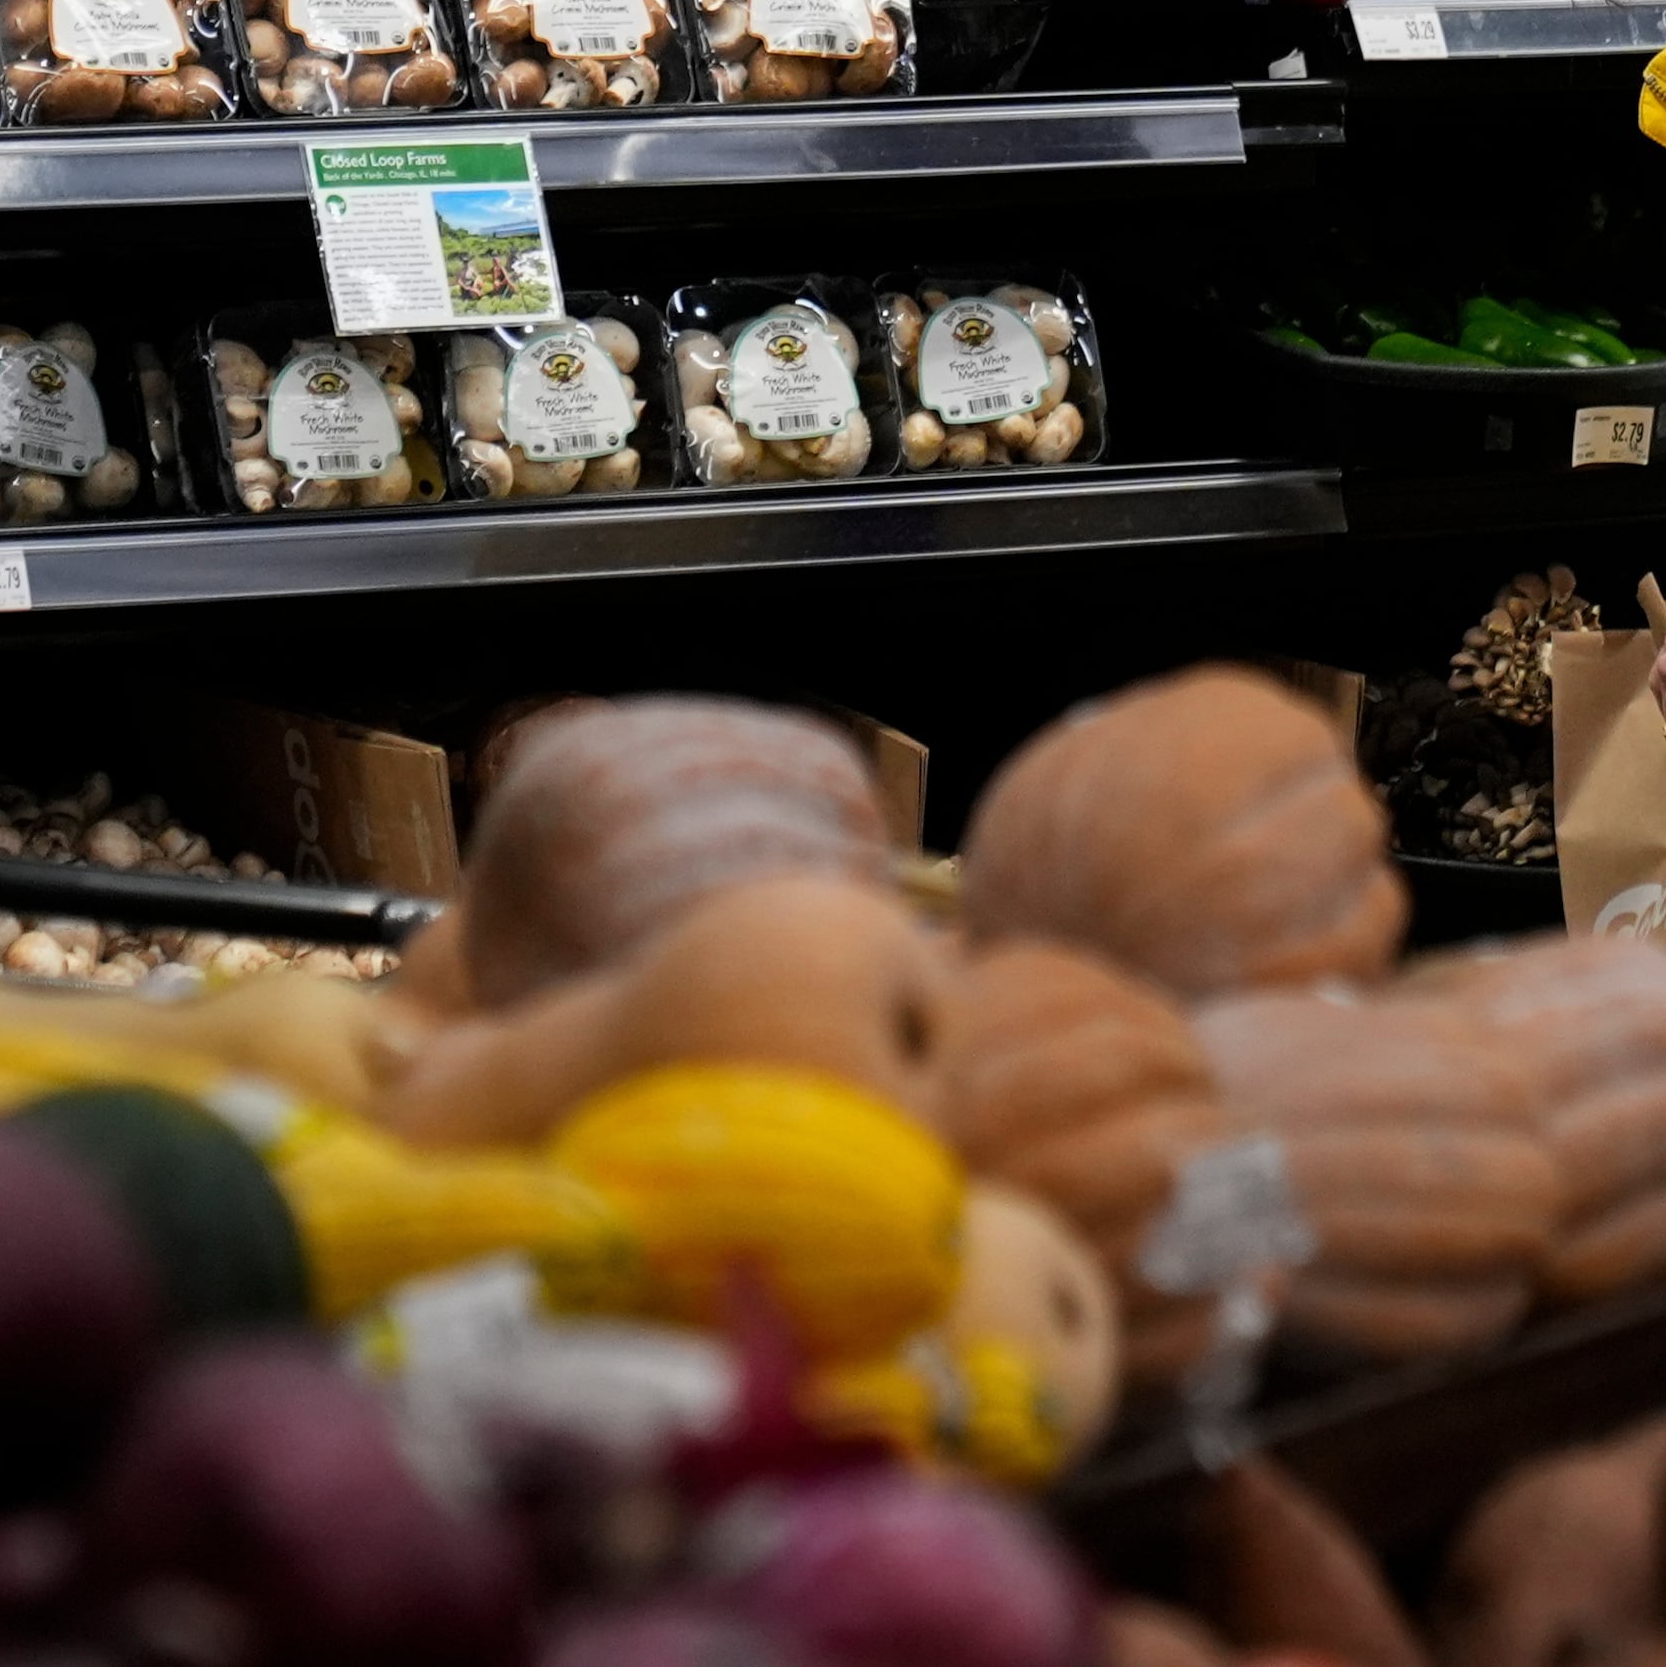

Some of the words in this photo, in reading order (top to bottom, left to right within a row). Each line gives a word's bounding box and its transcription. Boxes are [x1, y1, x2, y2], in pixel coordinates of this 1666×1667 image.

[320, 150, 367, 170] Closed
[369, 152, 405, 170] Loop
[406, 151, 447, 167] Farms
[948, 357, 978, 373] Fresh
[980, 352, 1012, 368] White
[762, 374, 789, 387] Fresh
[791, 371, 822, 384] White
[956, 366, 1008, 382] Mushrooms
[769, 383, 817, 396] Mushrooms
[535, 396, 565, 409] Fresh
[570, 392, 599, 405] White
[13, 398, 41, 415] Fresh
[44, 404, 75, 422] White
[544, 404, 595, 418] Mushrooms
[300, 413, 329, 425] Fresh
[334, 412, 364, 423] White
[308, 424, 359, 435] Mushrooms
[1611, 421, 1645, 446] $2.79
